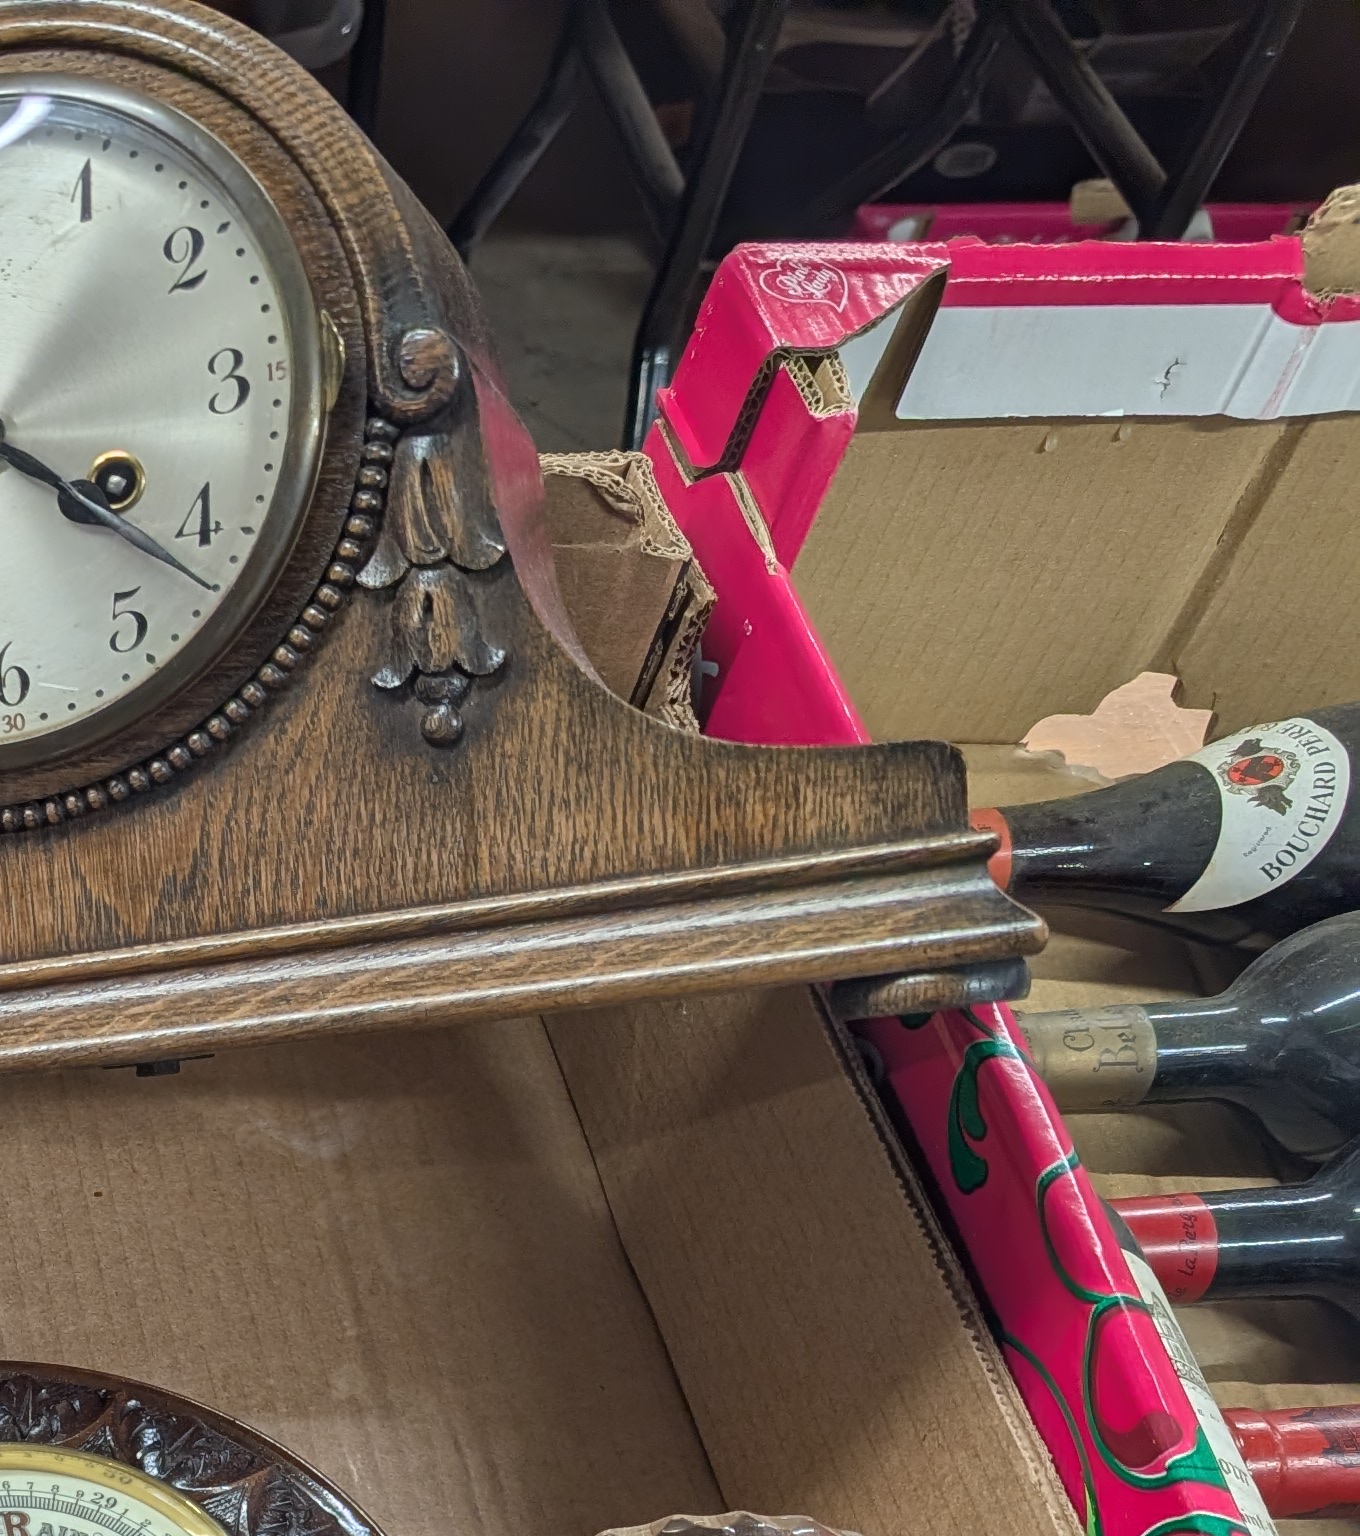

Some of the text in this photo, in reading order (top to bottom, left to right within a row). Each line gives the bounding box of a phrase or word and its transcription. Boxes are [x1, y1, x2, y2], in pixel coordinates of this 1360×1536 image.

[70, 158, 94, 223] 1
[162, 226, 208, 294] 2
[206, 346, 251, 416] 3
[265, 361, 287, 382] 15
[174, 481, 224, 548] 4
[107, 585, 149, 654] 5
[2, 712, 27, 734] 30
[1258, 760, 1337, 882] BOUCHARD
[90, 1491, 118, 1509] 29
